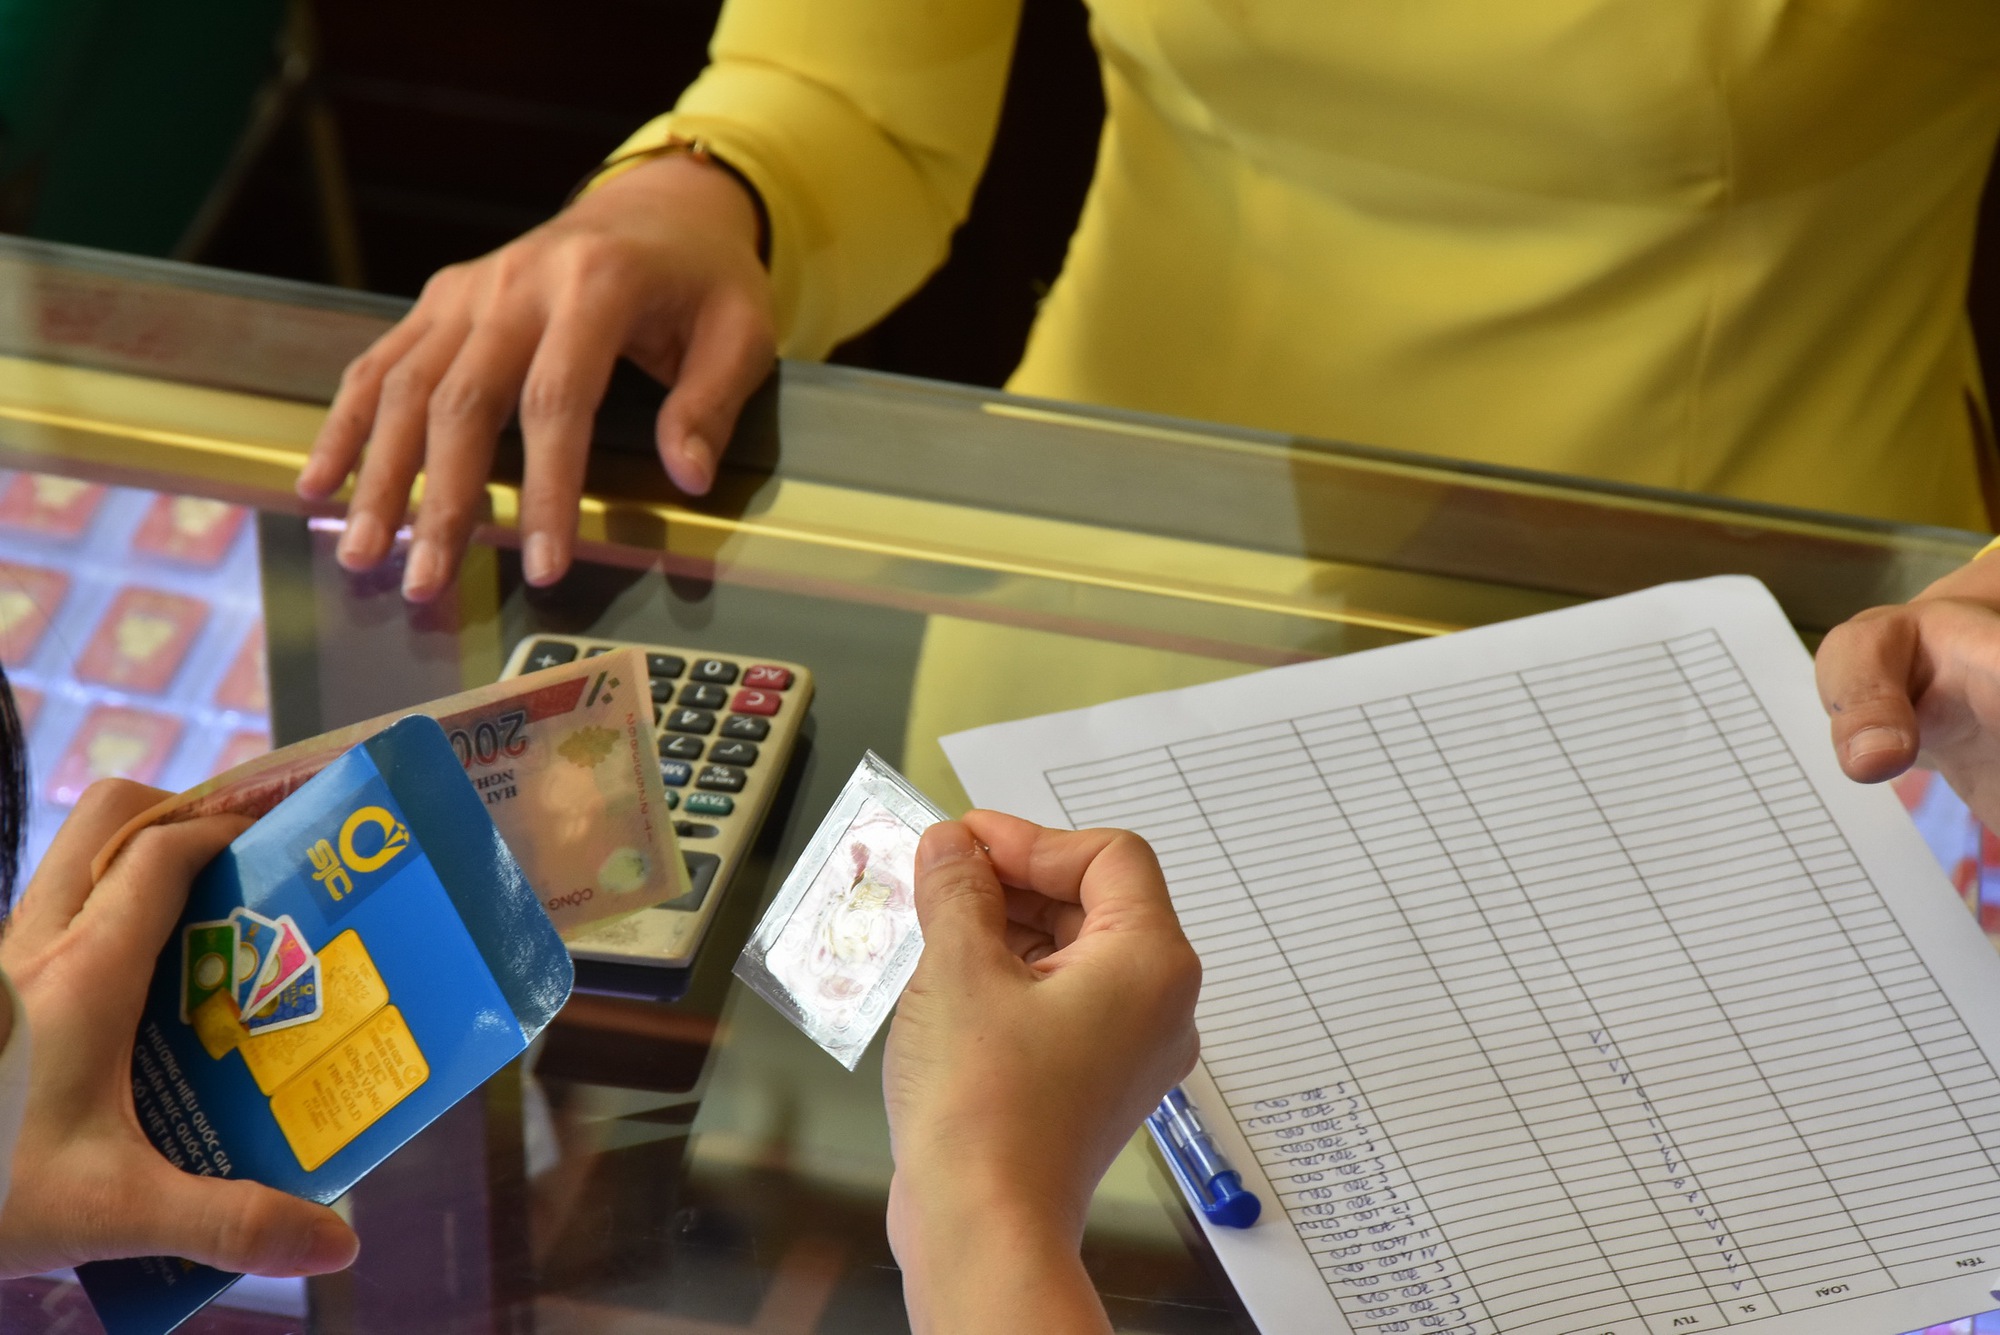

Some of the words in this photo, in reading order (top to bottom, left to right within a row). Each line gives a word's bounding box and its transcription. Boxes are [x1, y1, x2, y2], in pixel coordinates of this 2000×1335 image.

[703, 660, 722, 676] 0
[751, 668, 783, 681] AC
[695, 684, 706, 699] 1
[745, 691, 765, 706] C
[680, 710, 700, 724] 4
[667, 737, 685, 751] 7
[472, 768, 515, 791] NGH
[486, 784, 518, 805] HAI
[306, 839, 354, 902] SJC
[549, 887, 594, 911] CỘNG
[146, 1021, 182, 1081] THƯƠNG
[175, 1078, 199, 1112] HIỆU
[192, 1111, 220, 1152] QUỐC
[213, 1150, 233, 1177] GIA
[339, 1087, 363, 1122] GOLD
[146, 1104, 169, 1137] VIỆT
[161, 1135, 186, 1169] NAM
[158, 1089, 183, 1125] MỰC
[176, 1121, 203, 1163] QUỐC
[1955, 1255, 1986, 1268] TÊN
[1814, 1283, 1851, 1298] LOẠI
[1738, 1302, 1757, 1314] SL
[1672, 1314, 1700, 1328] TLV
